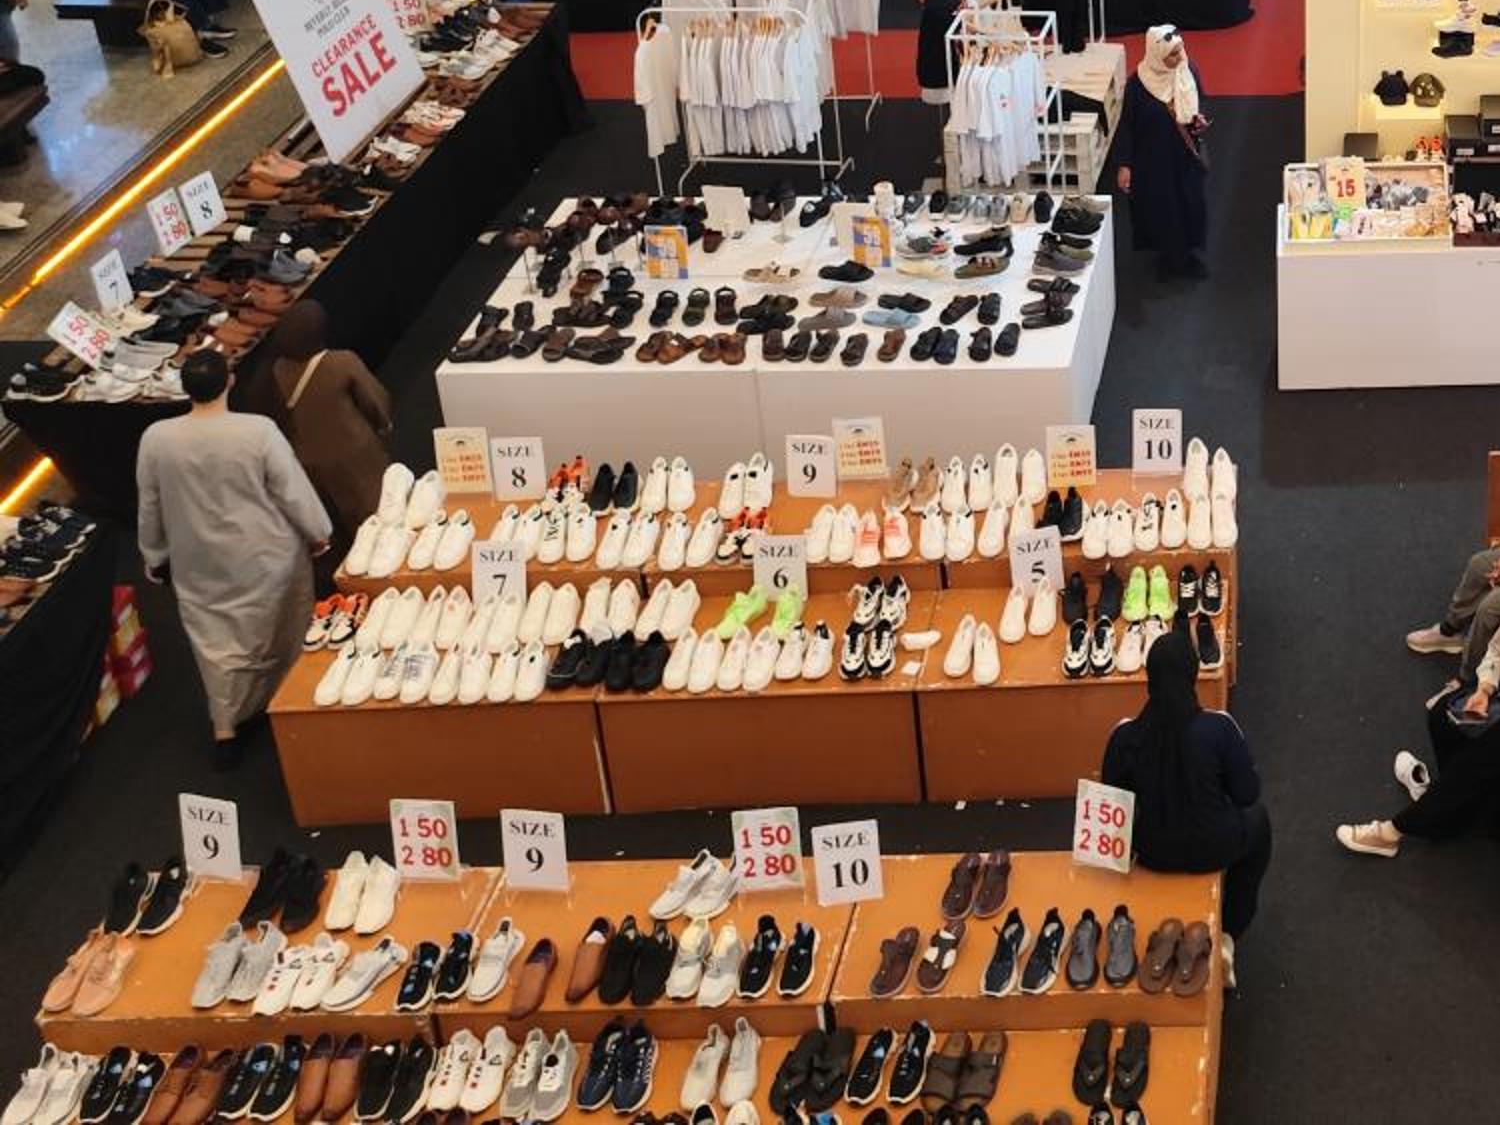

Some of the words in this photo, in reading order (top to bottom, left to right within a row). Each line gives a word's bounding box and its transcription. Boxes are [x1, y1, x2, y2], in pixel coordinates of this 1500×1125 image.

[312, 14, 377, 78] CLEARANCE
[322, 31, 397, 117] SALE
[1337, 178, 1355, 197] 15
[201, 200, 213, 219] 8
[1139, 418, 1175, 429] SIZE
[497, 444, 532, 458] SIZE
[791, 442, 826, 455] SIZE
[1145, 439, 1173, 460] 10
[511, 466, 527, 488] 8
[803, 463, 817, 484] 9
[479, 549, 517, 562] SIZE
[759, 545, 797, 558] SIZE
[1017, 539, 1053, 555] SIZE
[773, 567, 789, 589] 6
[1031, 560, 1046, 583] 5
[492, 574, 507, 596] 7
[187, 806, 228, 824] SIZE
[1098, 801, 1126, 828] 50
[417, 818, 447, 839] 50
[510, 820, 555, 838] SIZE
[760, 825, 792, 847] 50
[203, 834, 219, 859] 9
[821, 832, 868, 850] SIZE
[1097, 833, 1126, 860] 80
[422, 847, 452, 867] 80
[526, 847, 545, 871] 9
[764, 854, 796, 876] 80
[832, 858, 869, 888] 10
